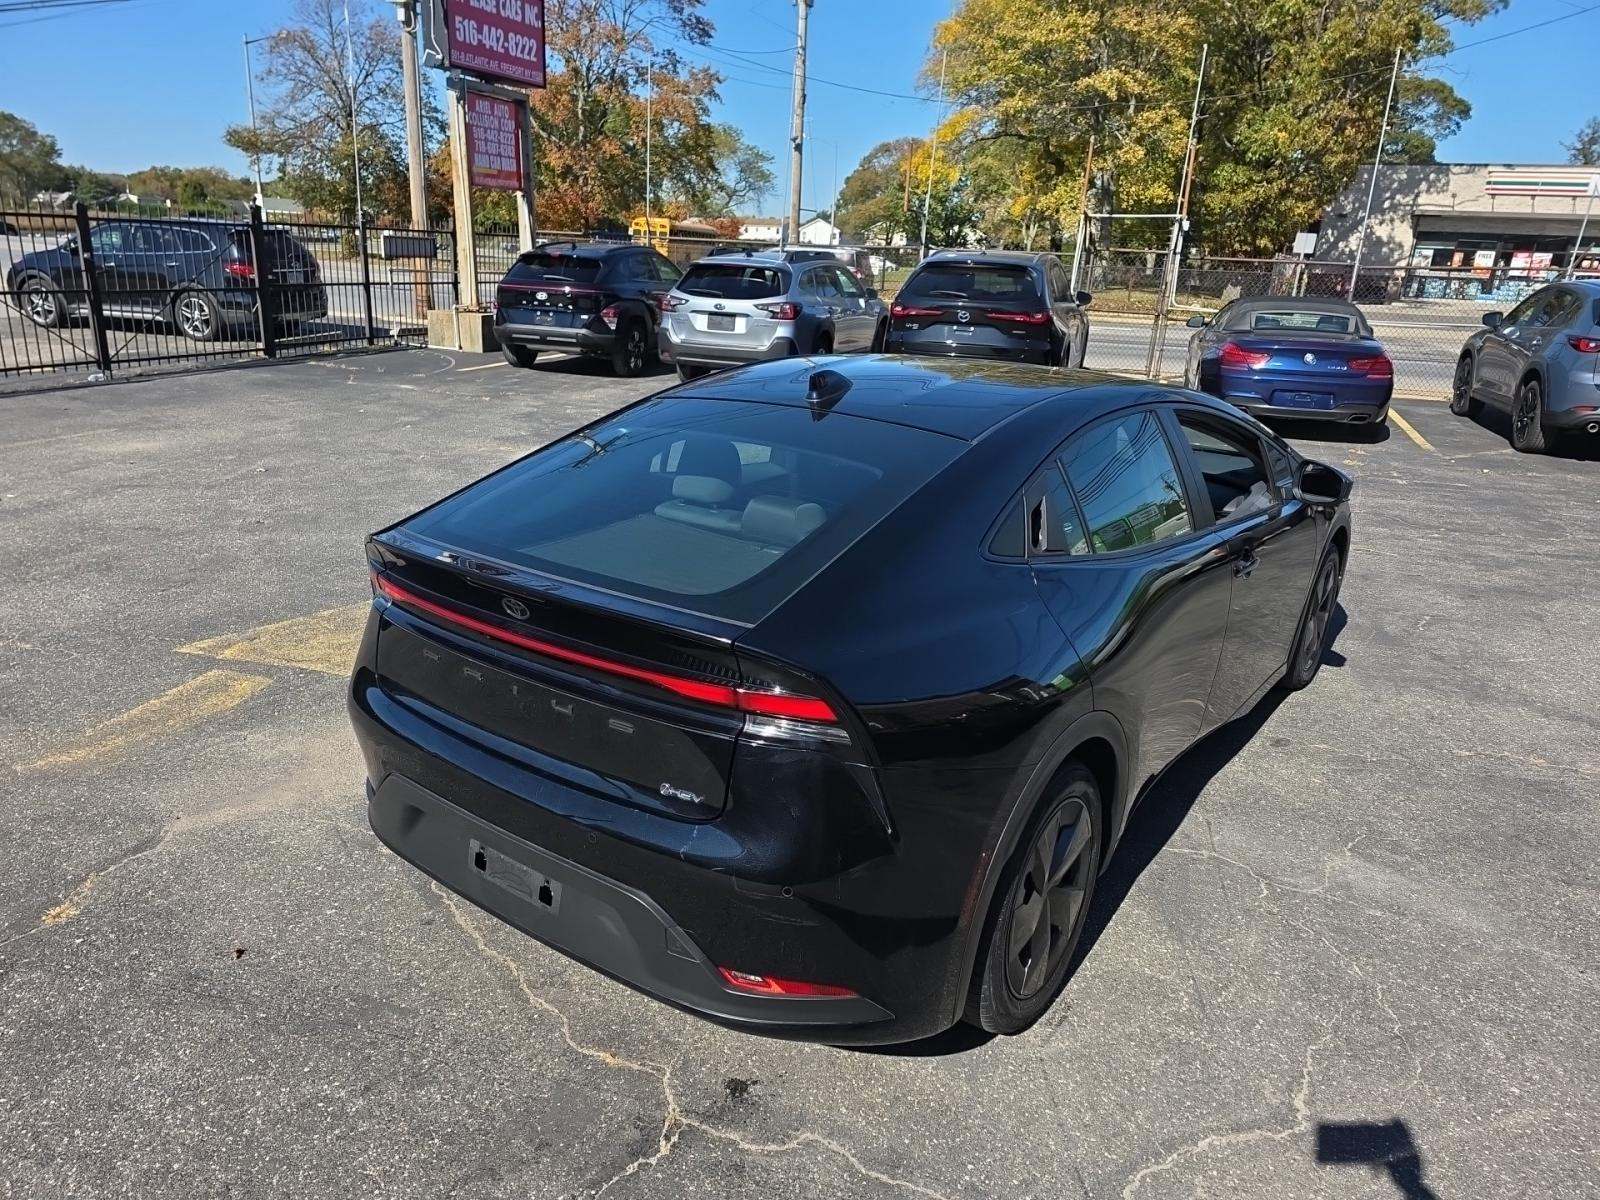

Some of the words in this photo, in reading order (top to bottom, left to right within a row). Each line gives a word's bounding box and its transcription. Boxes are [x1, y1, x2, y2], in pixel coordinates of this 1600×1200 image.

[470, 0, 497, 14] EASE
[500, 0, 521, 22] CARS
[525, 3, 541, 28] INC.
[455, 15, 537, 61] 516-442-8222
